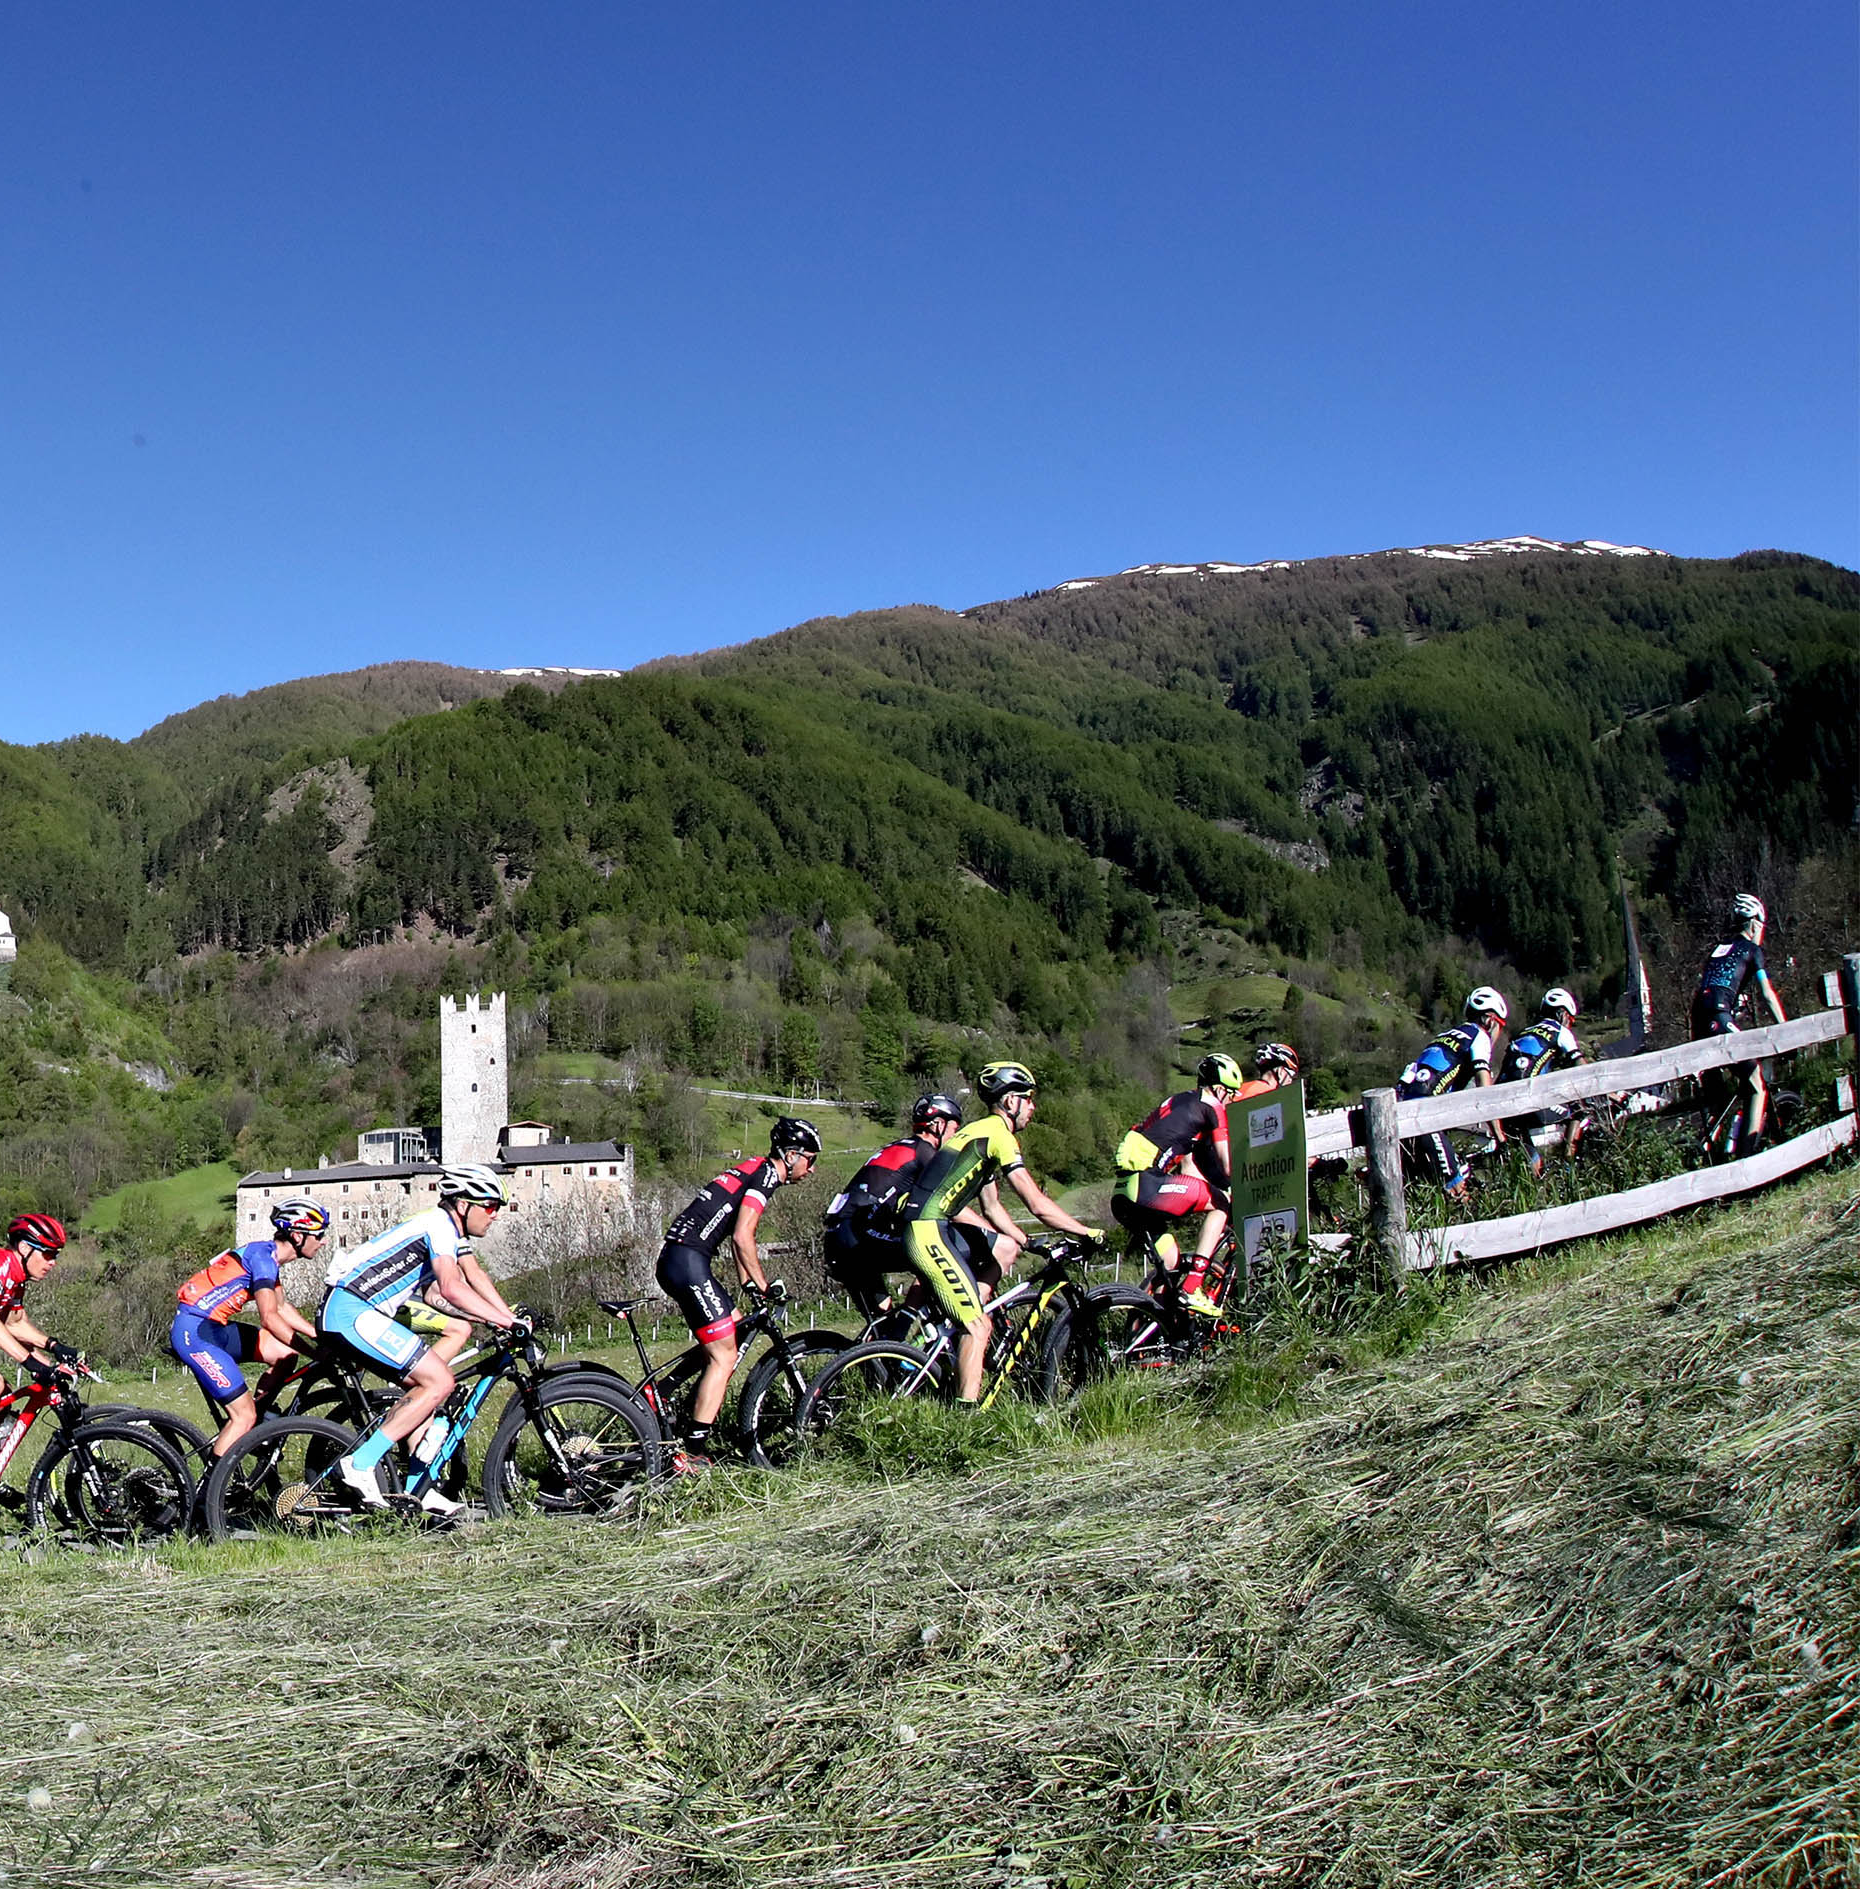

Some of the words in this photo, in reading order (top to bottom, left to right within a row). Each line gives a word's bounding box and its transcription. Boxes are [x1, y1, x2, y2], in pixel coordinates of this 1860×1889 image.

[940, 1159, 983, 1213] SCOTT
[1241, 1155, 1295, 1183] Attention
[1251, 1183, 1285, 1203] TRAFFIC
[925, 1244, 974, 1310] SCOTT
